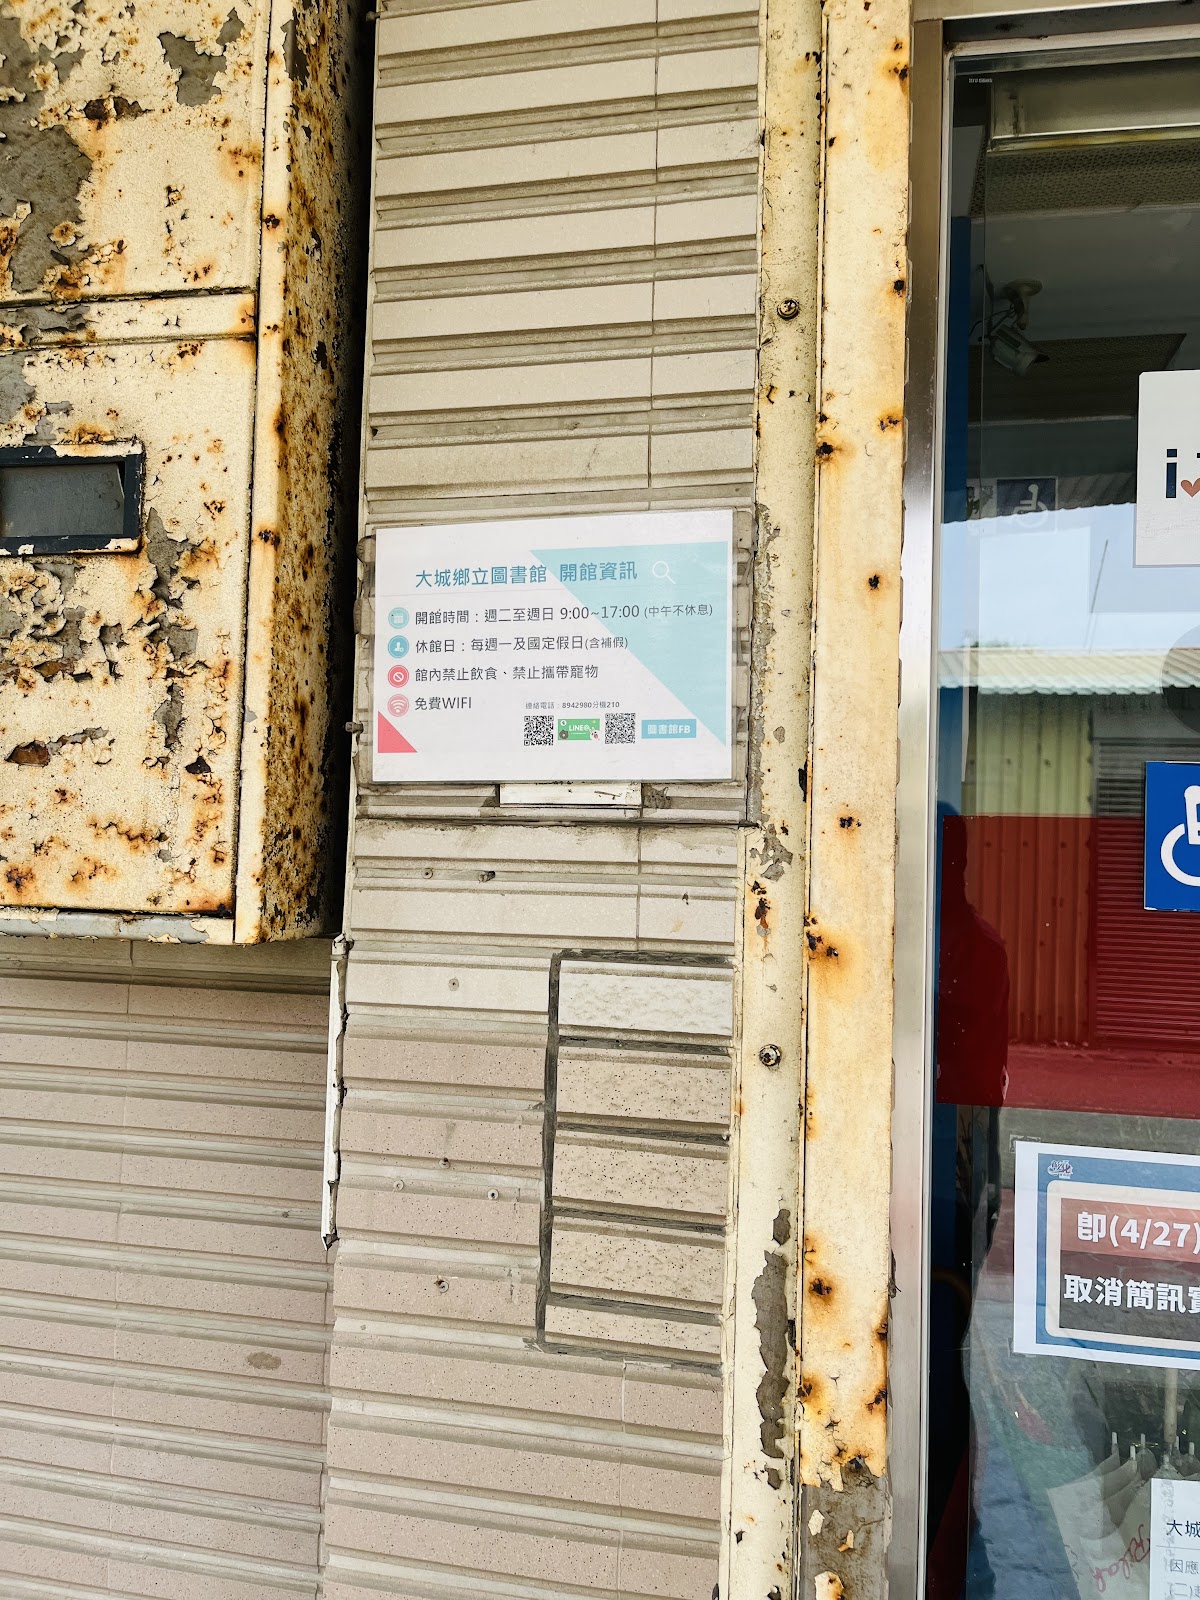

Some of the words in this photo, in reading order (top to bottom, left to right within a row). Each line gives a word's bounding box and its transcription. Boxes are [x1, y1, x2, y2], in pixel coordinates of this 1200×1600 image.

[415, 564, 548, 588] 大城鄉立圖書館
[559, 561, 638, 582] 開館資訊
[415, 607, 554, 625] 開館時間：週二至週日
[559, 604, 640, 620] 9:00~17:00
[643, 603, 714, 619] (中午不休息)
[415, 635, 629, 654] 休館日：每週一及國定假日(含補假)
[415, 664, 599, 682] 館內禁止飲食、禁止攜帶寵物
[414, 696, 472, 711] 免費WIFI
